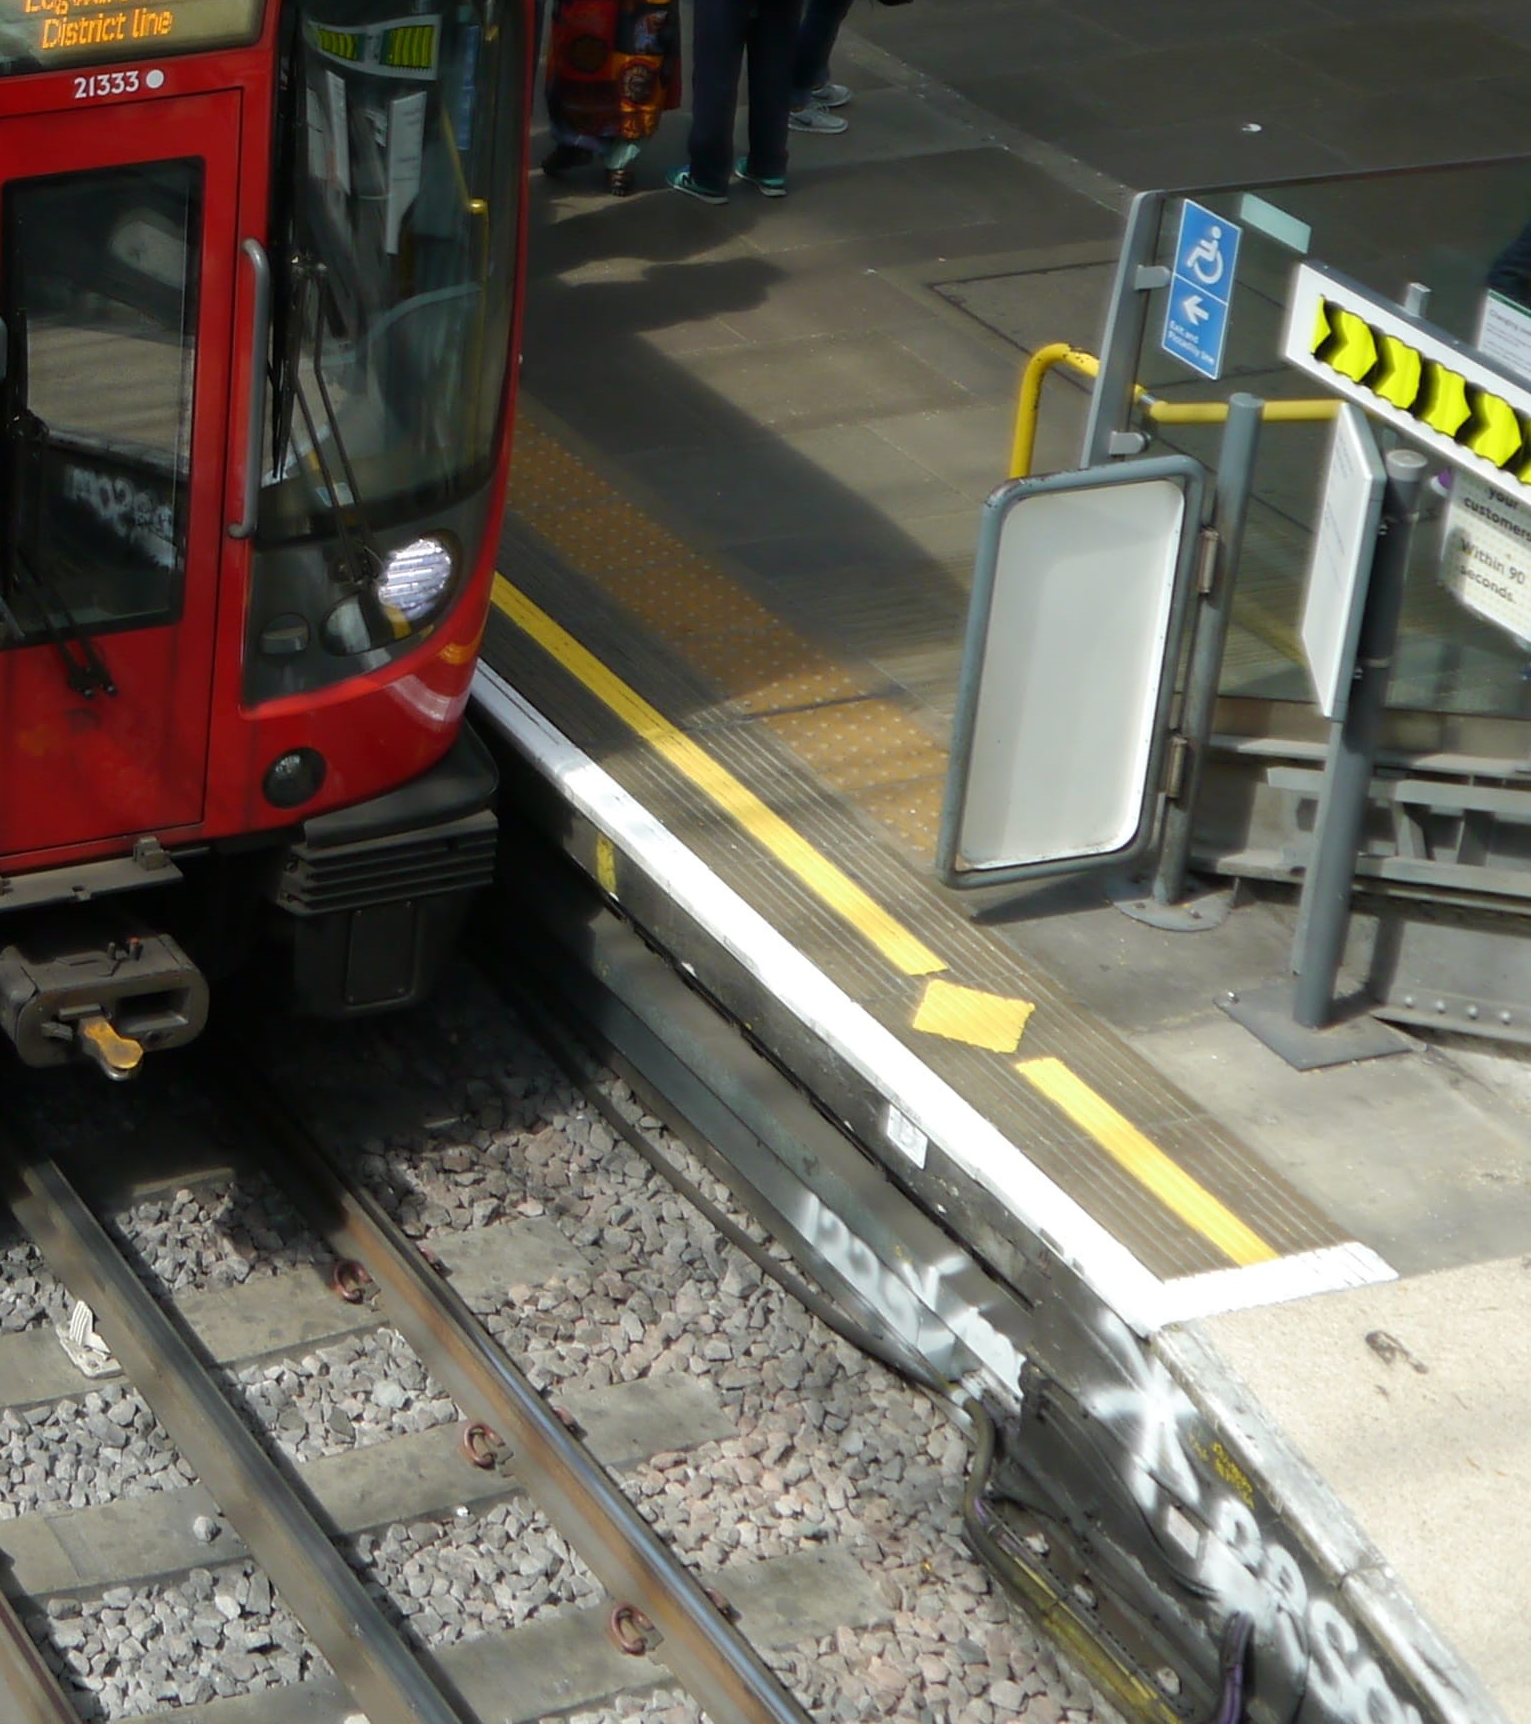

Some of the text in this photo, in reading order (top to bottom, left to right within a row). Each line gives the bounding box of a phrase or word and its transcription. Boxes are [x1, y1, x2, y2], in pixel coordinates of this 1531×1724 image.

[42, 7, 174, 50] District line
[74, 70, 140, 99] 21333
[1487, 486, 1520, 511] your
[1460, 537, 1526, 585] Within 90
